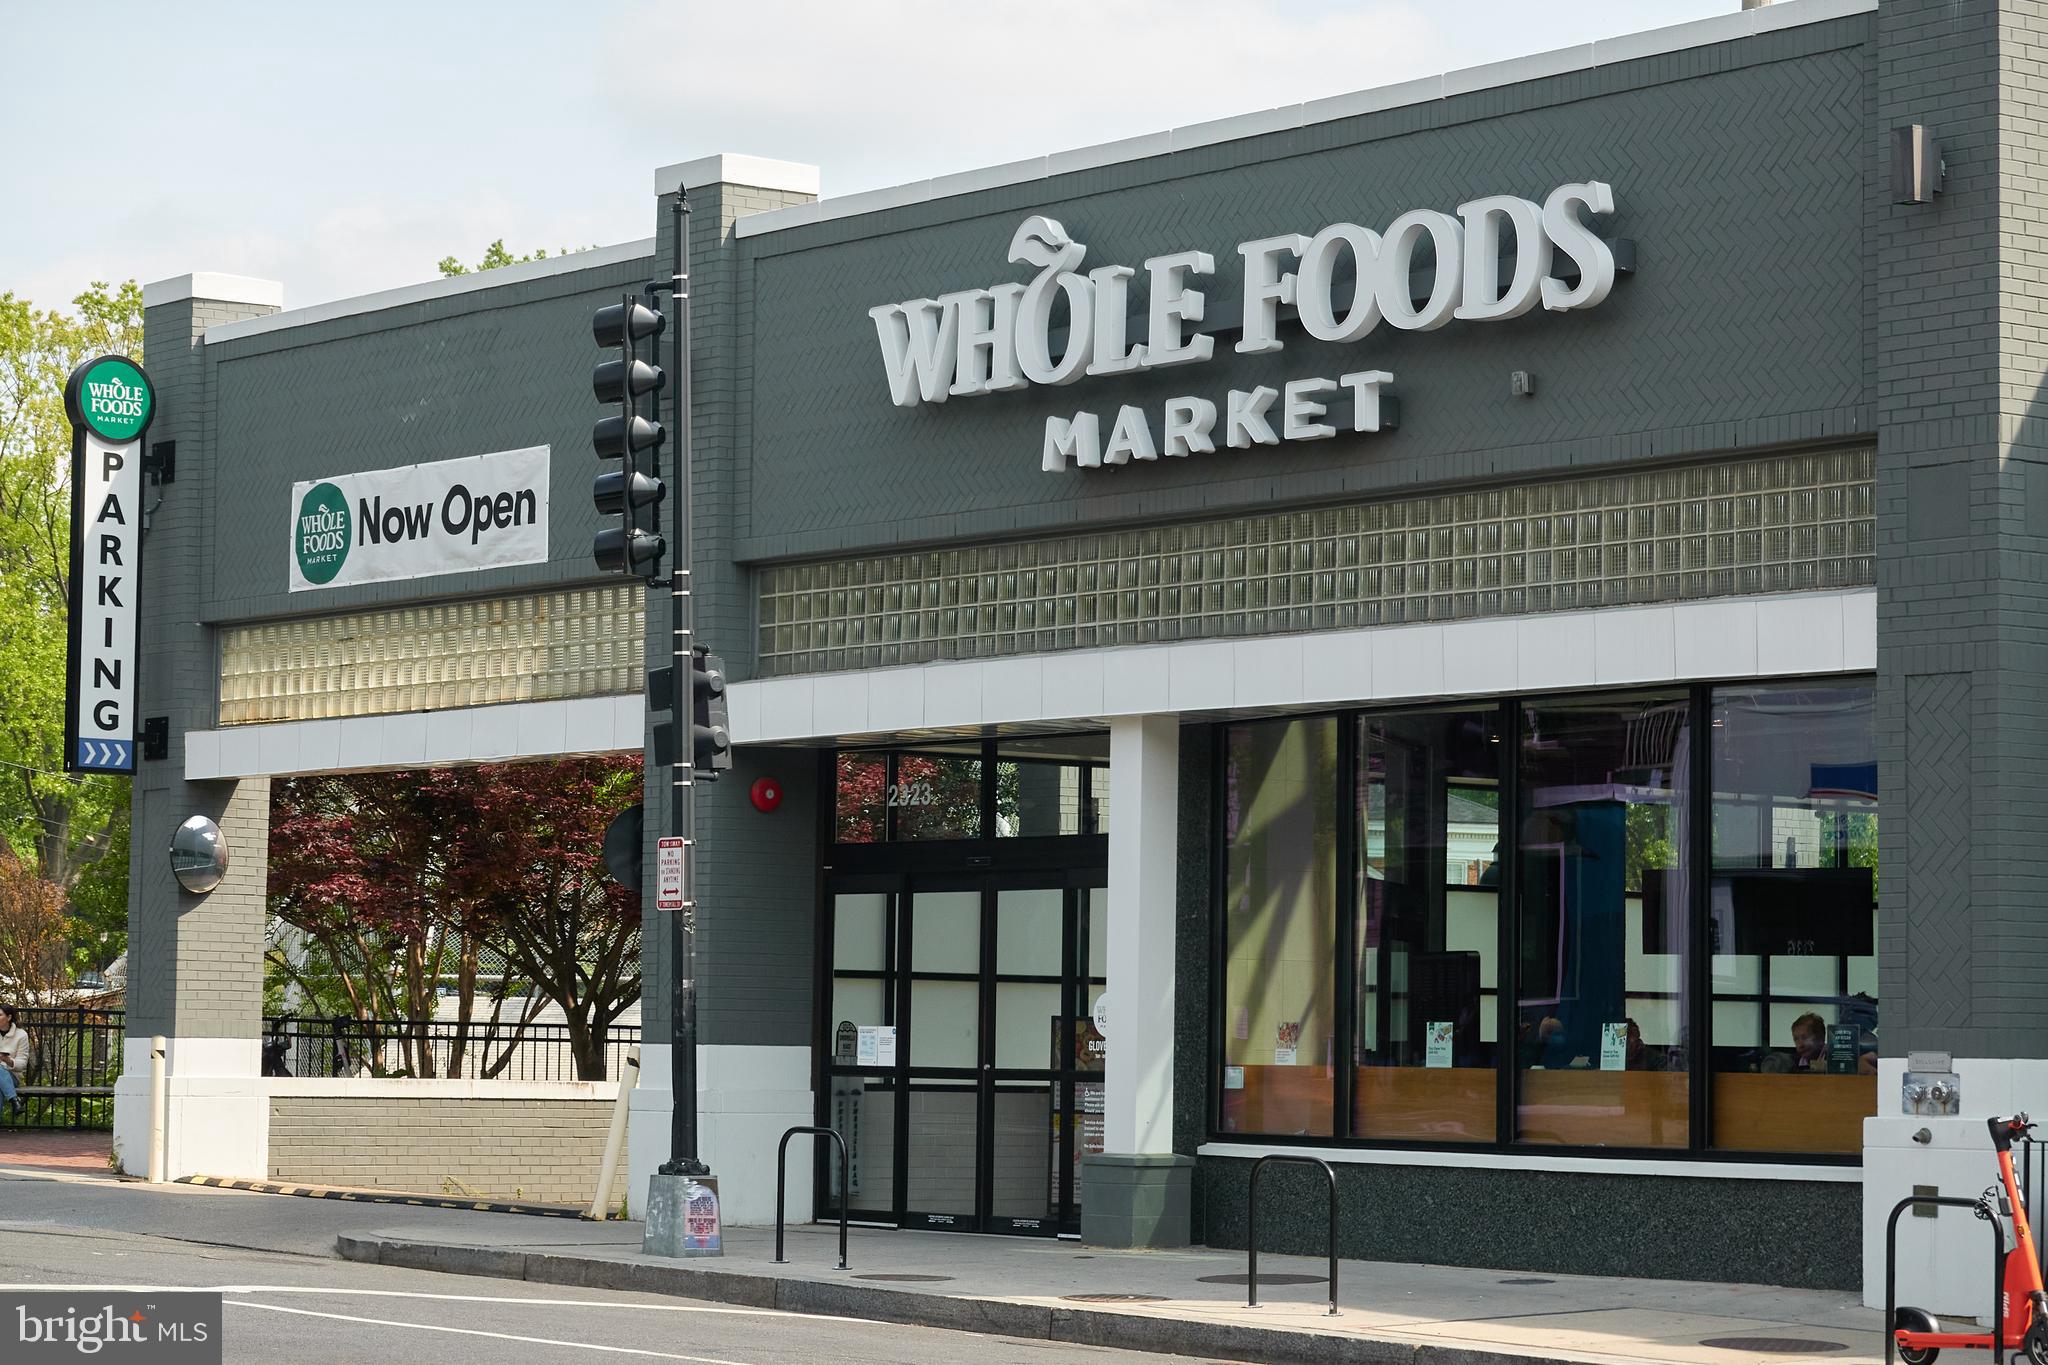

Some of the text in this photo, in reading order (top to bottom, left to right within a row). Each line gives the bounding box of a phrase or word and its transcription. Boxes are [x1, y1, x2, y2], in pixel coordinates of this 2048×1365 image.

[868, 180, 1615, 407] WHOLE FOODS
[88, 377, 143, 401] WHOLE
[91, 398, 142, 416] FOODS
[97, 415, 134, 424] MARKET
[1041, 369, 1394, 472] MARKET
[301, 504, 345, 535] WHOLE
[358, 484, 536, 547] Now Open
[303, 531, 344, 554] FOODS
[307, 553, 337, 565] MARKET
[93, 451, 126, 731] PARKING
[888, 782, 931, 807] 2323
[661, 858, 681, 866] PARKING
